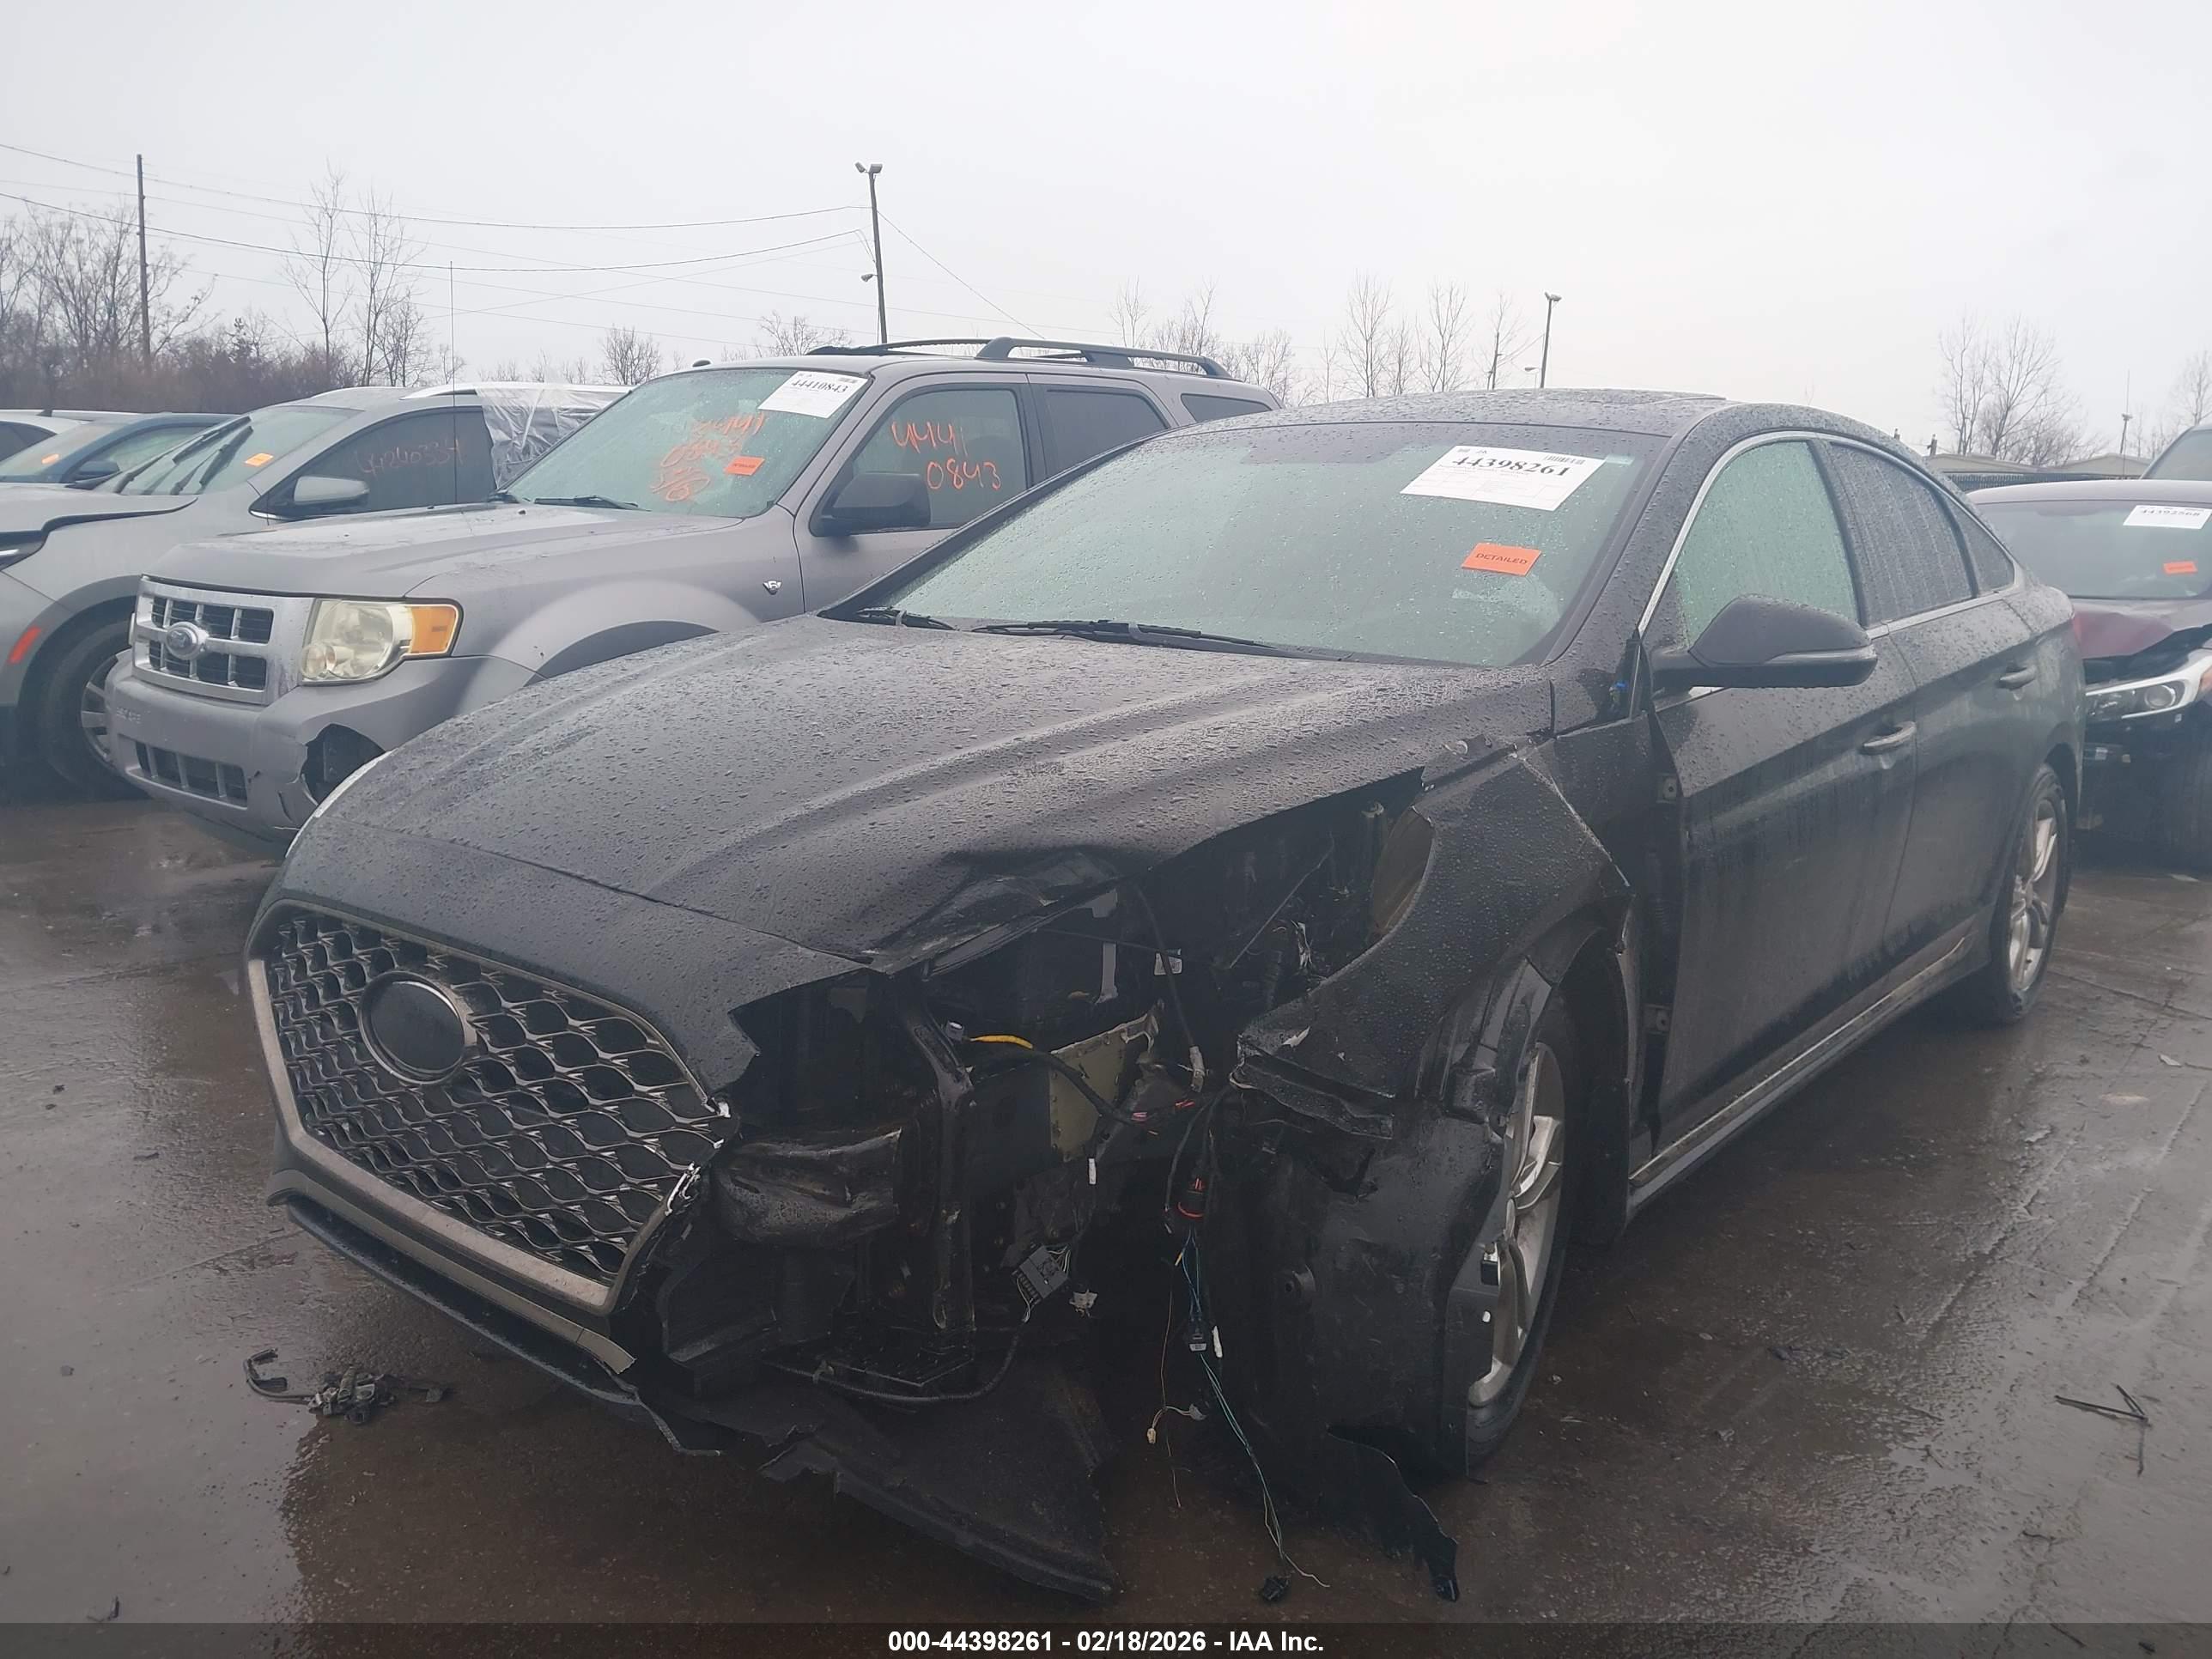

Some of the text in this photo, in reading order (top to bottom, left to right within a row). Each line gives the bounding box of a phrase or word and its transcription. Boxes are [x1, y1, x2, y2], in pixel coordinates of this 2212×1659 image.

[792, 379, 848, 393] 44410843
[891, 421, 968, 457] 4441
[927, 458, 1001, 489] 0843
[1453, 456, 1571, 477] 44398261
[1475, 552, 1528, 564] DETAILED
